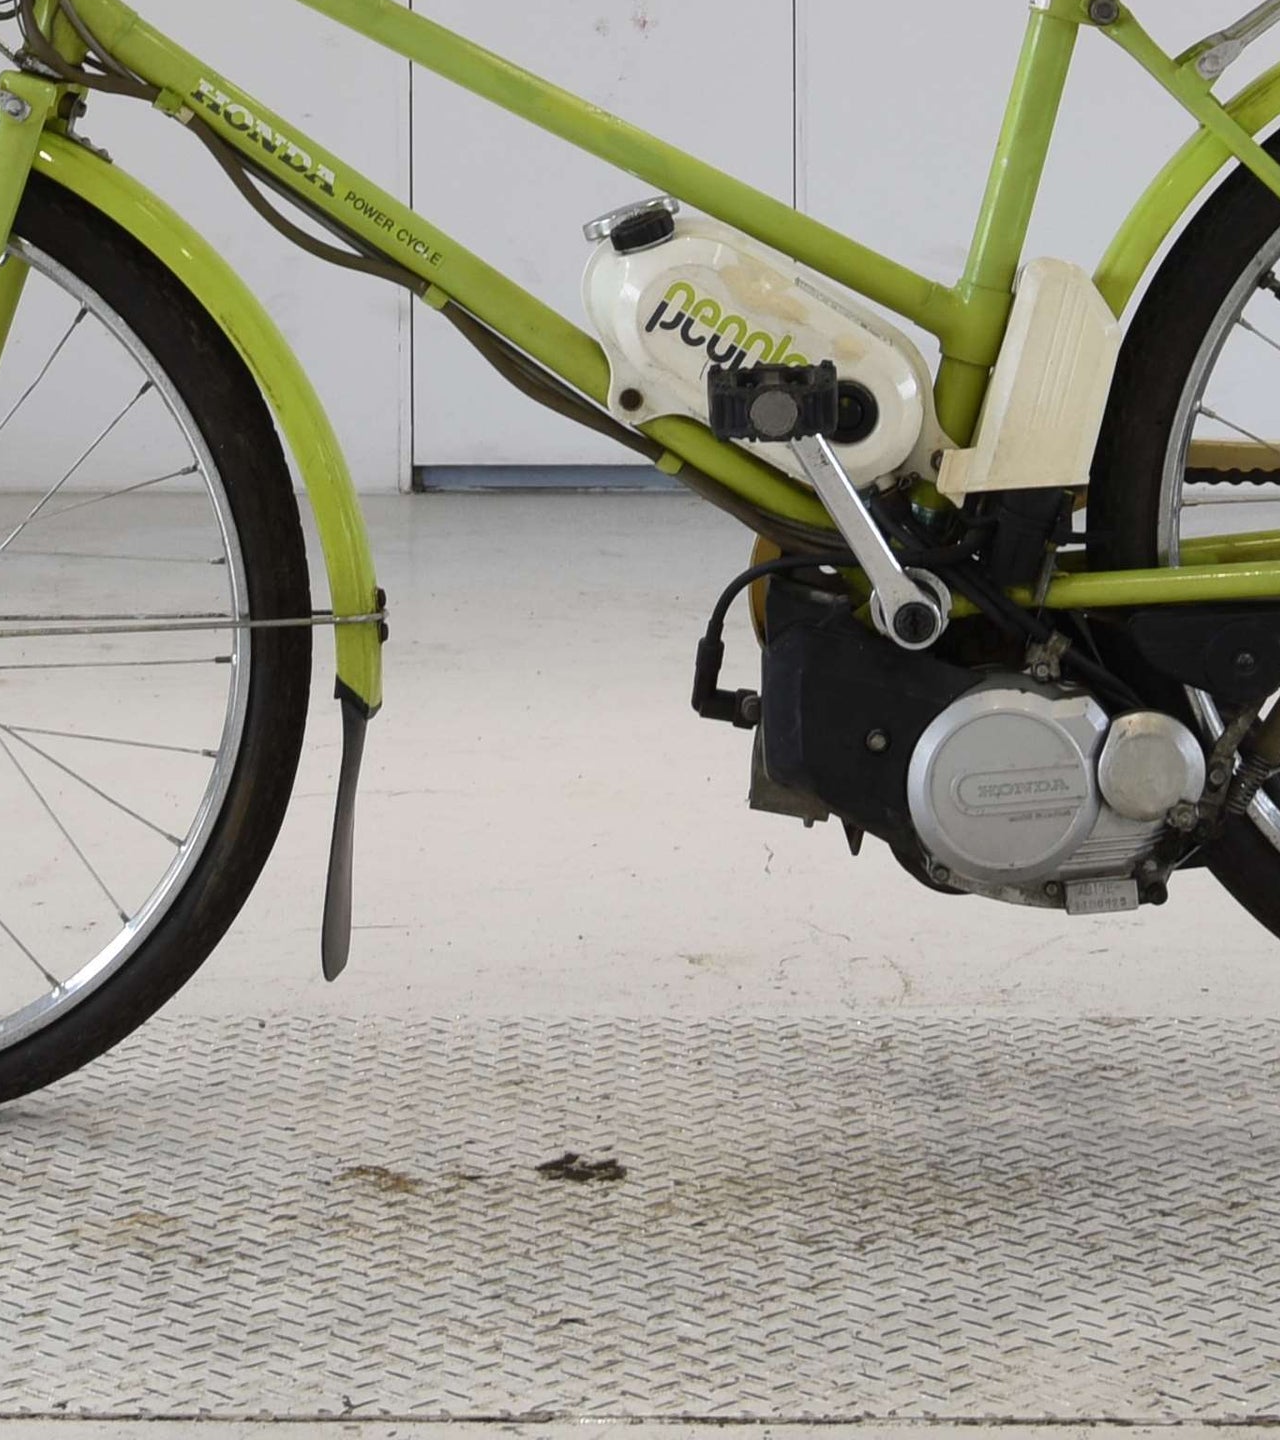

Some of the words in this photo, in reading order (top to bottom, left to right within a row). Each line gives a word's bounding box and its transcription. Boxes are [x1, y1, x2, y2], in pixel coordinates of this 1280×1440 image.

[190, 77, 336, 197] HONDA
[344, 190, 395, 233] POWER
[396, 229, 443, 266] CYCLE
[645, 281, 809, 372] peopl
[977, 778, 1070, 798] HONDA
